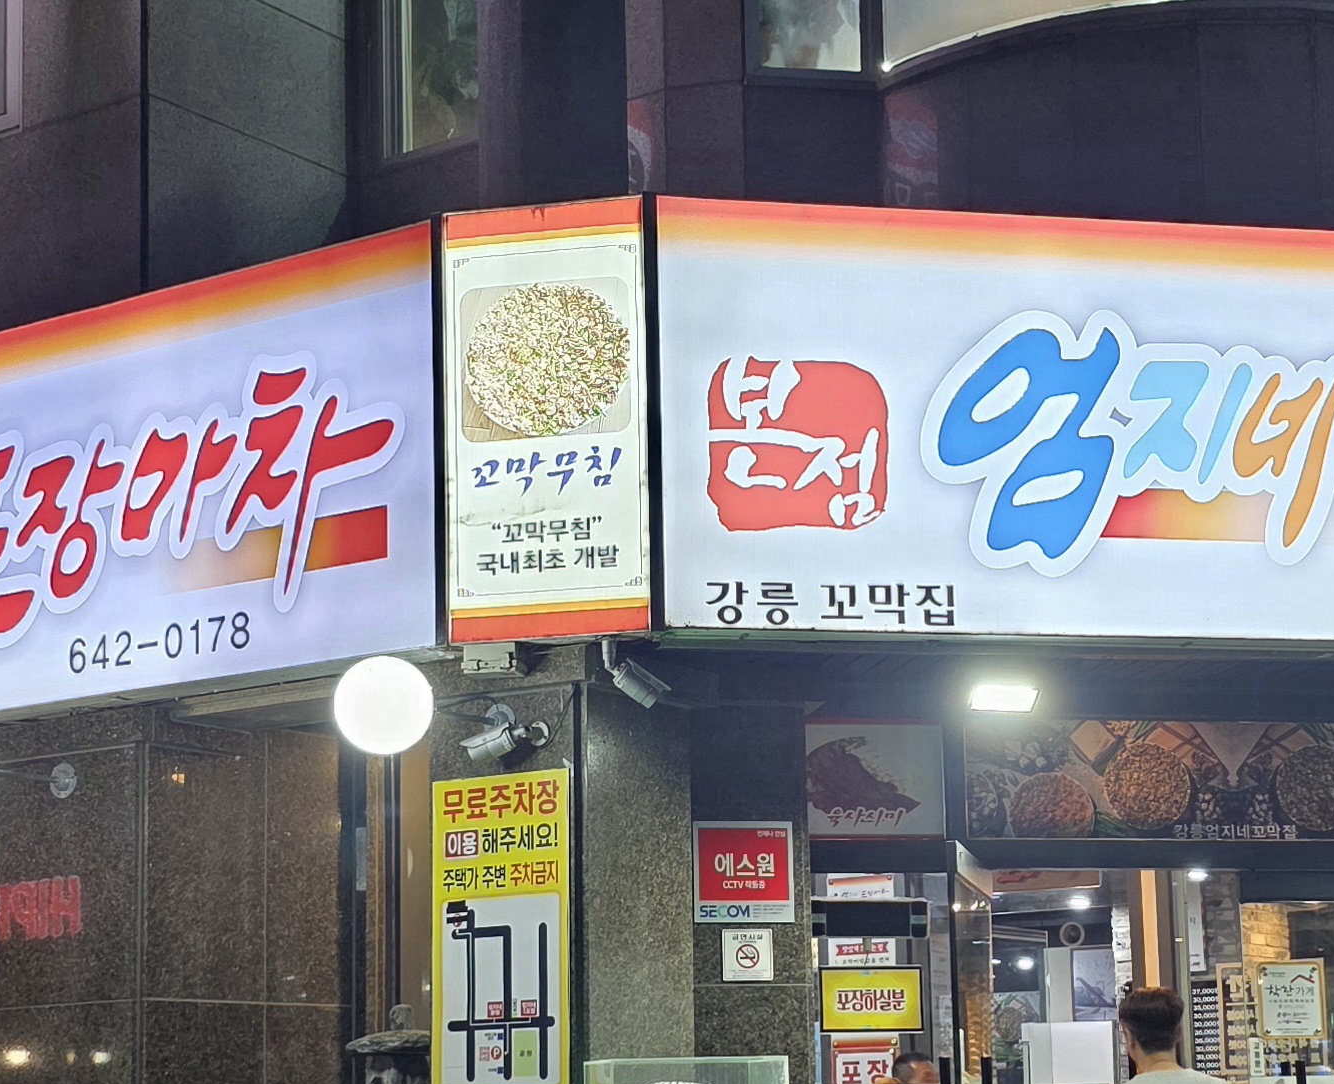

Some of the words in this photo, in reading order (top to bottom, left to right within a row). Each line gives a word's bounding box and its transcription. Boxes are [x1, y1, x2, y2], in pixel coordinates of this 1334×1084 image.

[708, 356, 889, 532] 본점
[470, 445, 623, 496] 꼬막무침
[491, 516, 603, 545] “꼬막무침”
[475, 546, 567, 576] 국내최초
[573, 544, 620, 571] 개발
[706, 581, 799, 627] 강릉
[821, 581, 955, 627] 꼬막집
[68, 612, 252, 675] 642-0178
[443, 779, 560, 823] 무료주차장
[827, 808, 905, 829] 육사시미
[446, 831, 478, 857] 이용
[482, 822, 558, 854] 해주세요!
[442, 867, 479, 892] 주택가
[482, 864, 506, 888] 주변
[510, 859, 559, 888] 주차금지
[714, 852, 776, 877] 에스원
[723, 880, 744, 889] CCTV
[700, 904, 750, 918] SECOM
[837, 989, 906, 1011] 포장하실분
[842, 1060, 889, 1084] 포장
